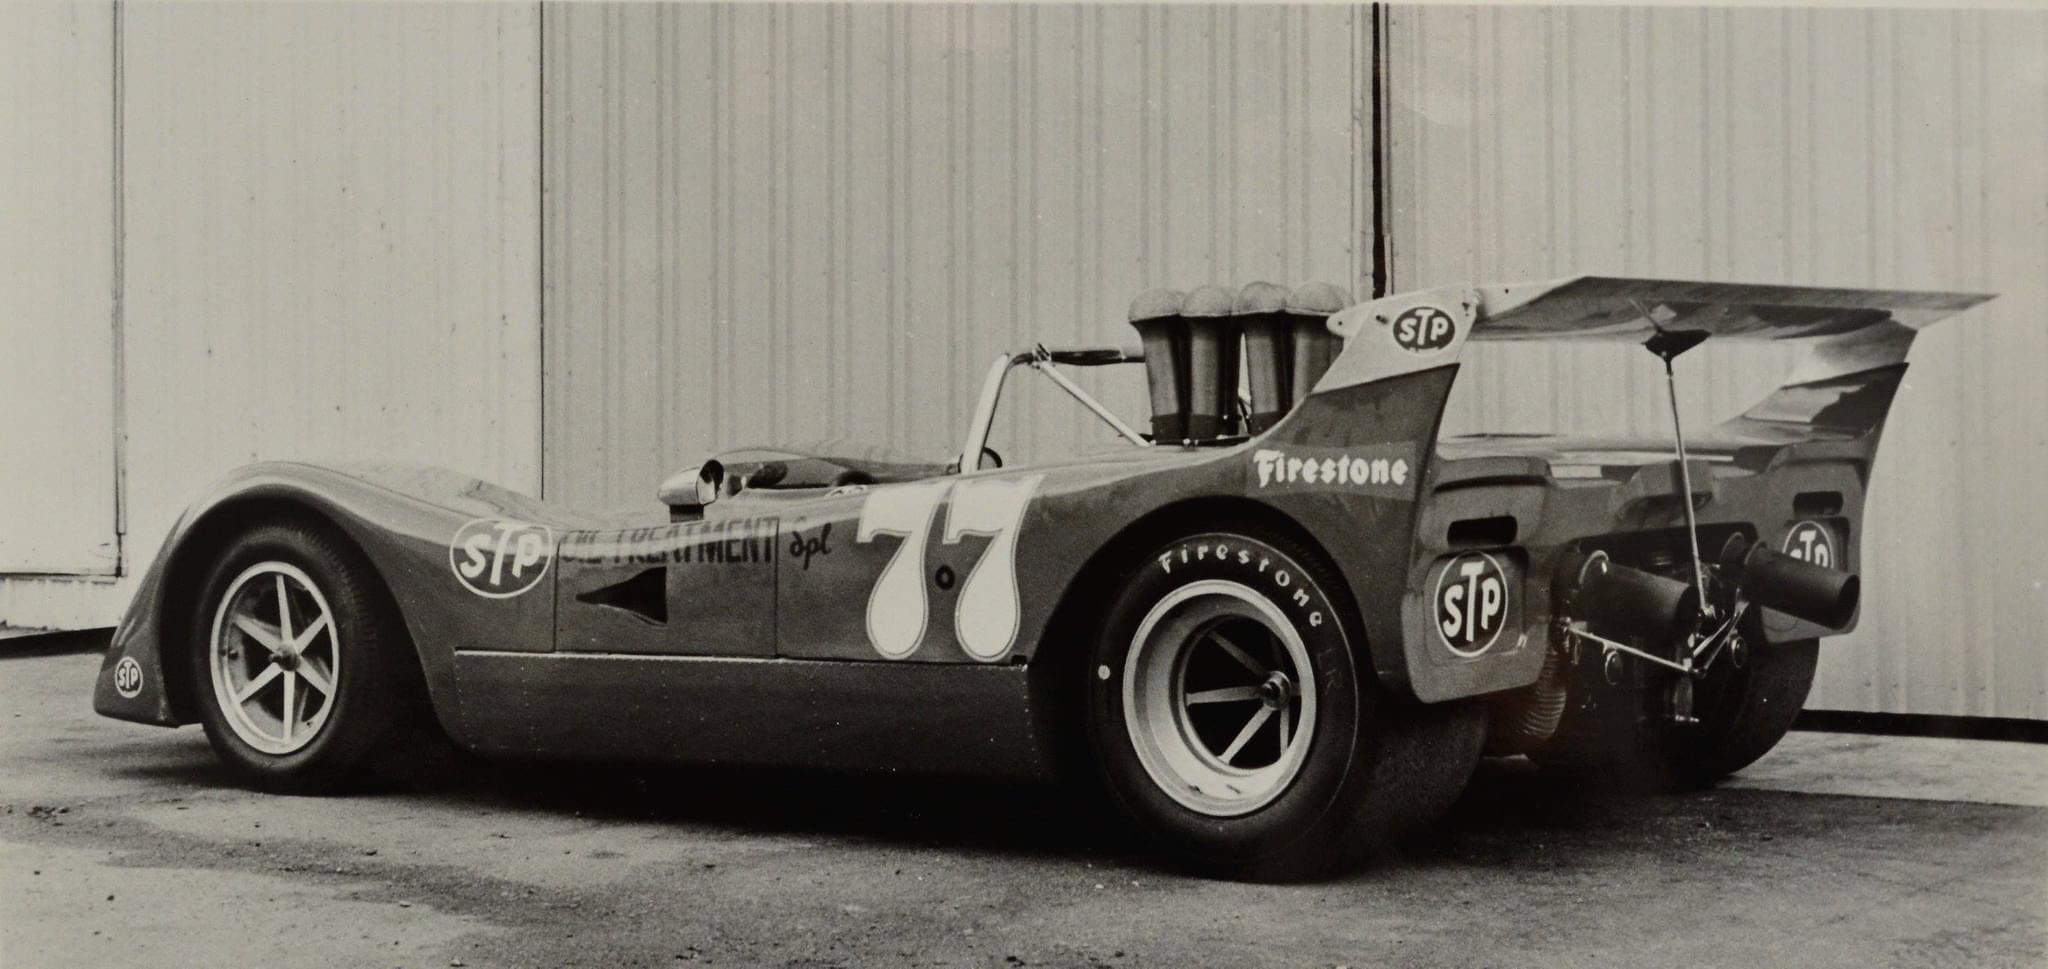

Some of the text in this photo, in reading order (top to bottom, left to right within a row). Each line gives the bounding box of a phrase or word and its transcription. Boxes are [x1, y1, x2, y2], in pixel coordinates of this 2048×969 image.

[1399, 309, 1449, 345] STP
[1253, 450, 1408, 488] Firestone
[459, 521, 542, 586] STP
[857, 475, 1045, 662] 77
[1790, 530, 1828, 568] TP
[1158, 544, 1322, 627] Firestone
[1443, 561, 1500, 642] STP
[119, 661, 139, 689] STP
